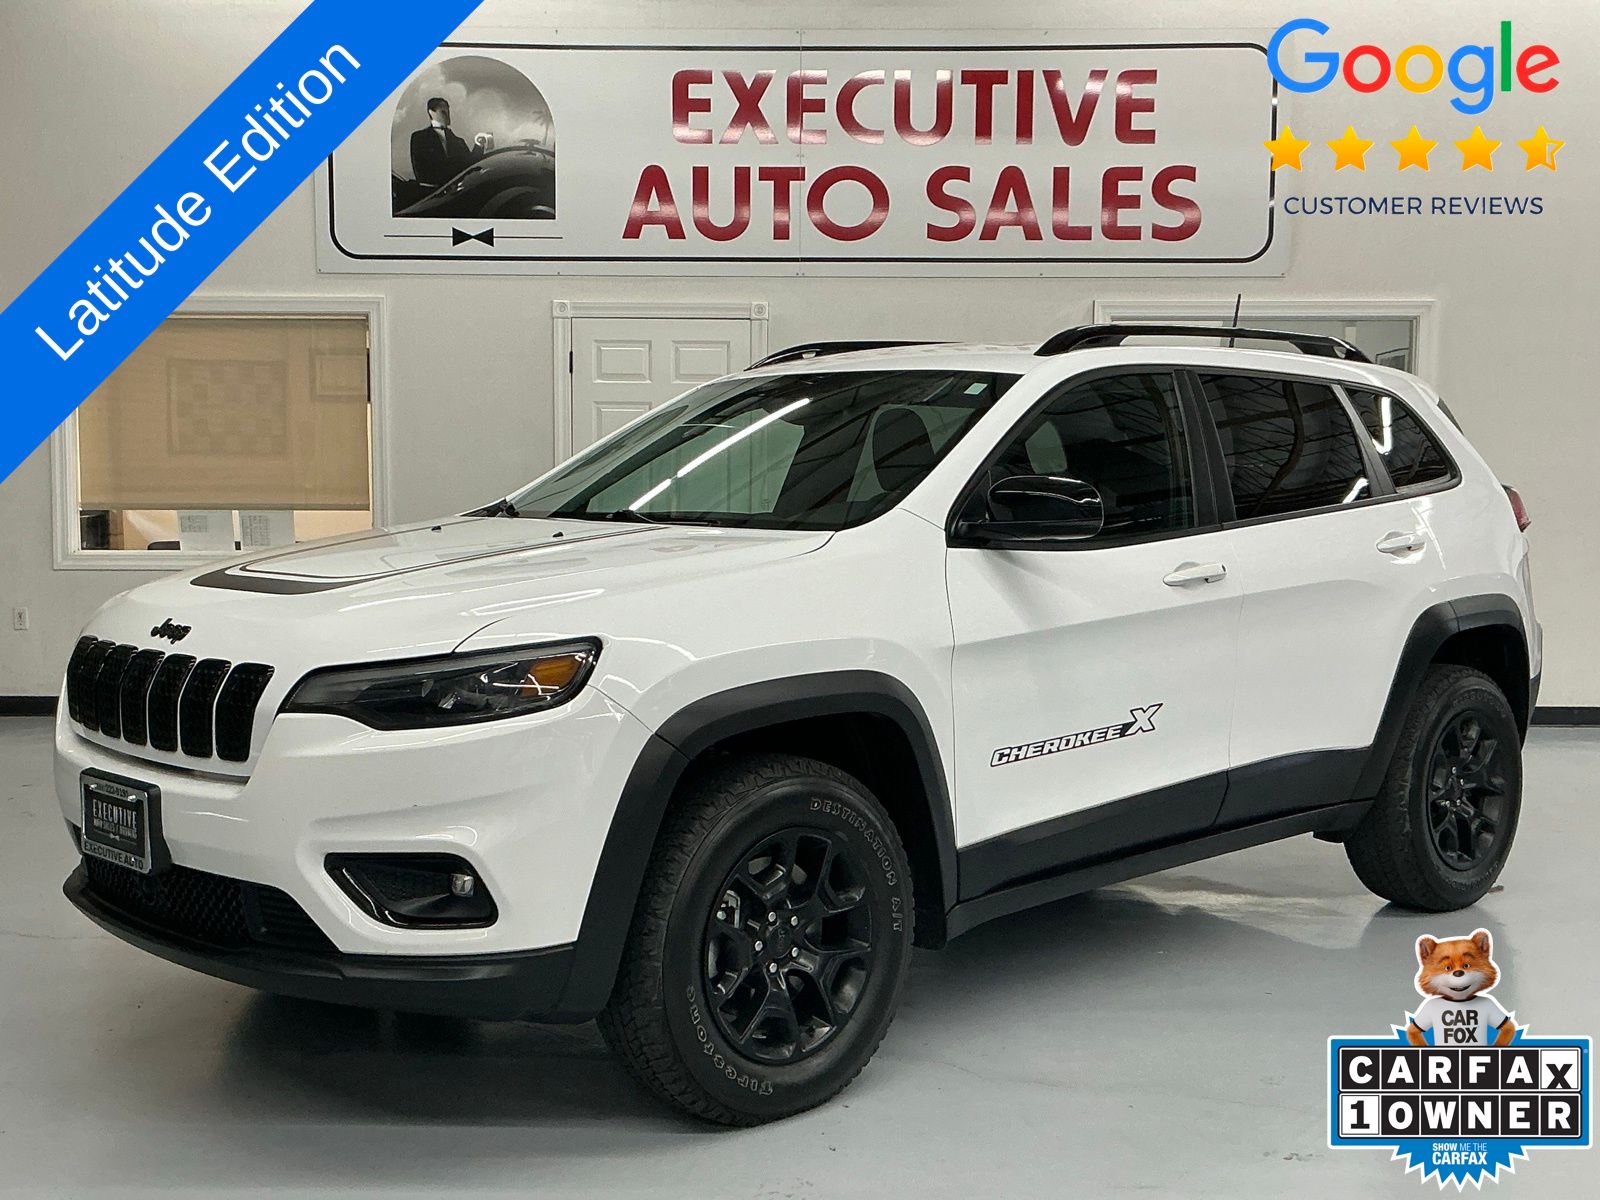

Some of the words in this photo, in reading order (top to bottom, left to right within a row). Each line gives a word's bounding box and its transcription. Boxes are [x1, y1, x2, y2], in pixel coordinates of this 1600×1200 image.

[672, 69, 1157, 147] EXECUTIVE
[622, 164, 890, 242] AUTO
[926, 164, 1203, 242] SALES
[151, 618, 191, 645] Jeep
[990, 724, 1124, 767] CHEROKEE
[1126, 703, 1163, 736] X
[92, 799, 137, 829] EXECUTIVE
[84, 841, 123, 863] EXECUTIVE
[124, 853, 144, 871] AUTO
[810, 797, 898, 887] DESTINATION
[891, 896, 903, 933] A/T
[686, 985, 774, 1096] Firestone
